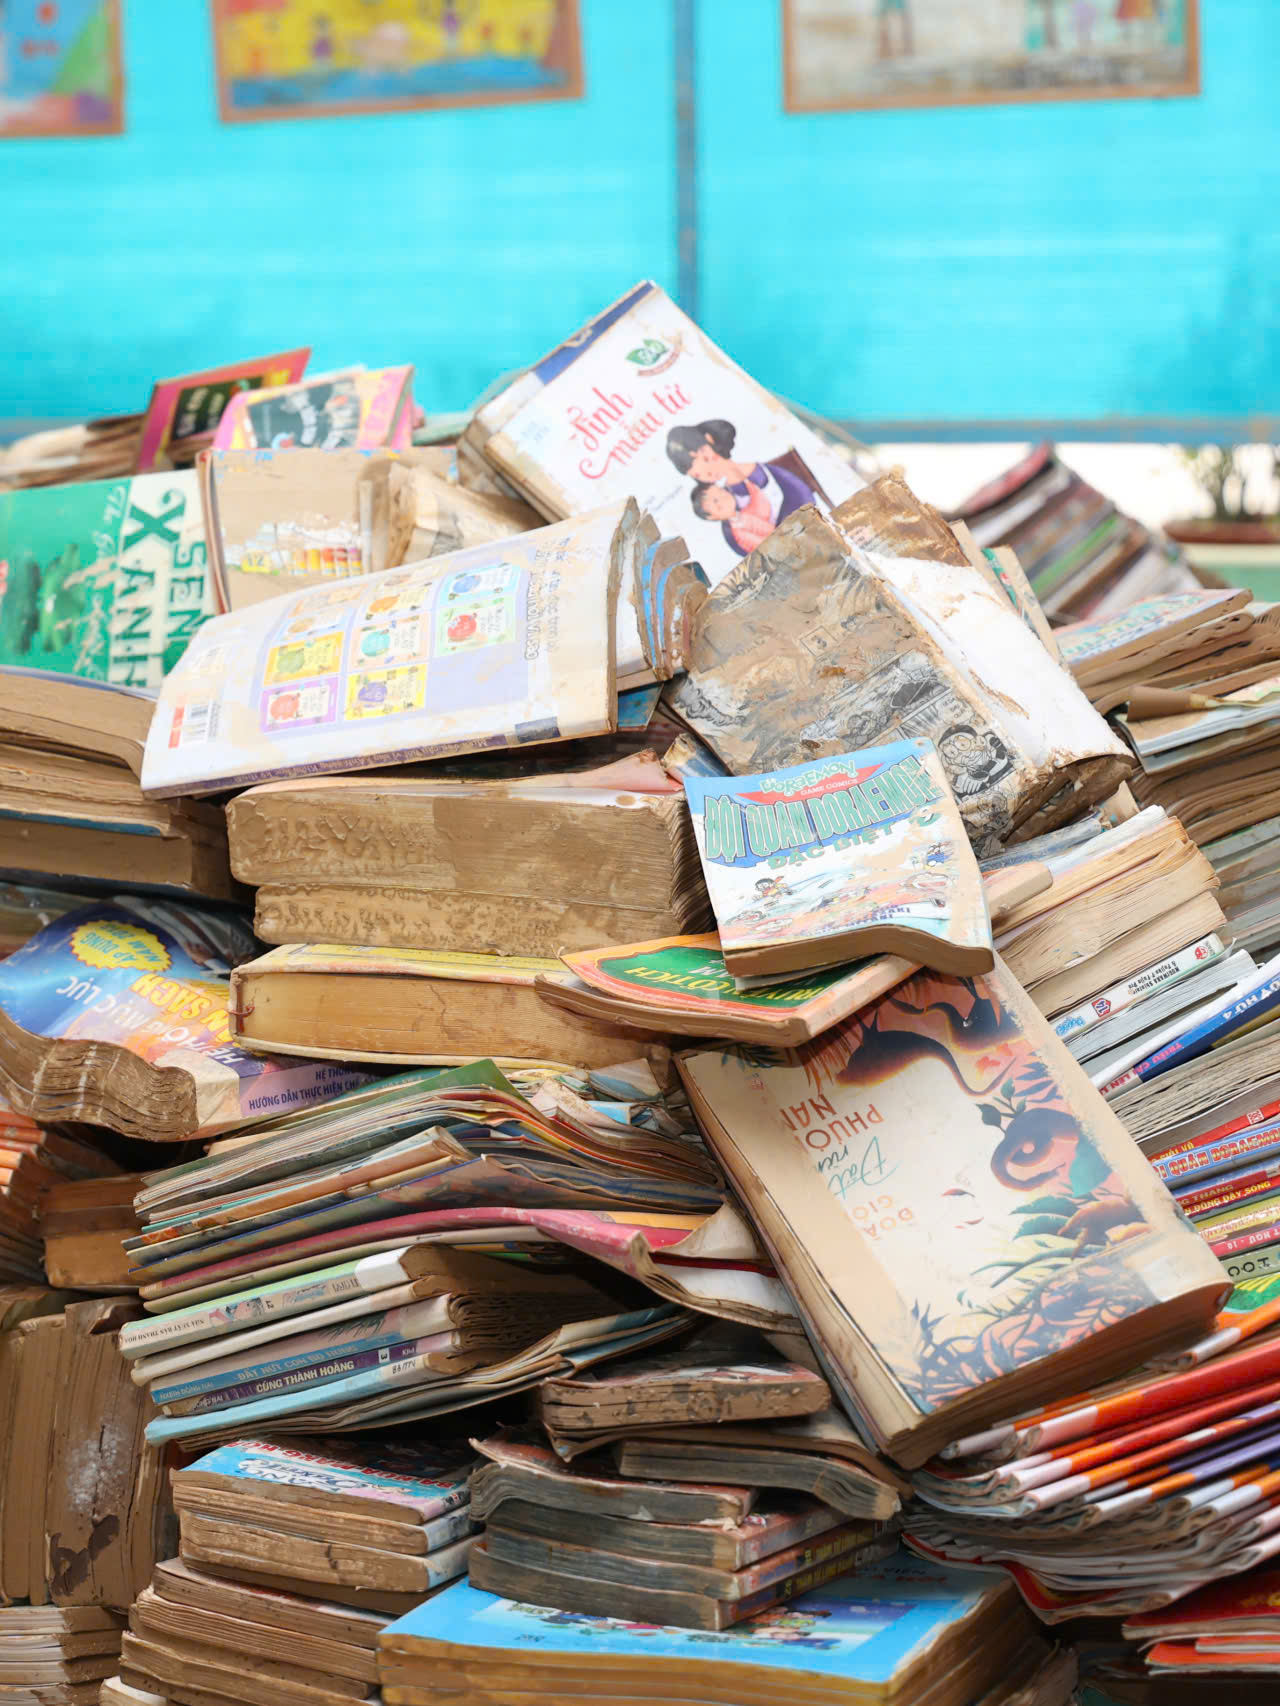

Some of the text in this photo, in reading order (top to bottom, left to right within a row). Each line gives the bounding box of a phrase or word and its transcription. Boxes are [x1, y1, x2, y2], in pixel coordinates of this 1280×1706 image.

[759, 760, 859, 797] DORAEMON
[703, 795, 747, 864] ĐỘI
[747, 800, 818, 856] QUÂN
[1095, 998, 1111, 1017] 14
[1168, 1151, 1210, 1179] QUÂN
[255, 1377, 284, 1394] CÚNG
[284, 1369, 319, 1386] THÀNH
[319, 1360, 355, 1378] HOÀNG
